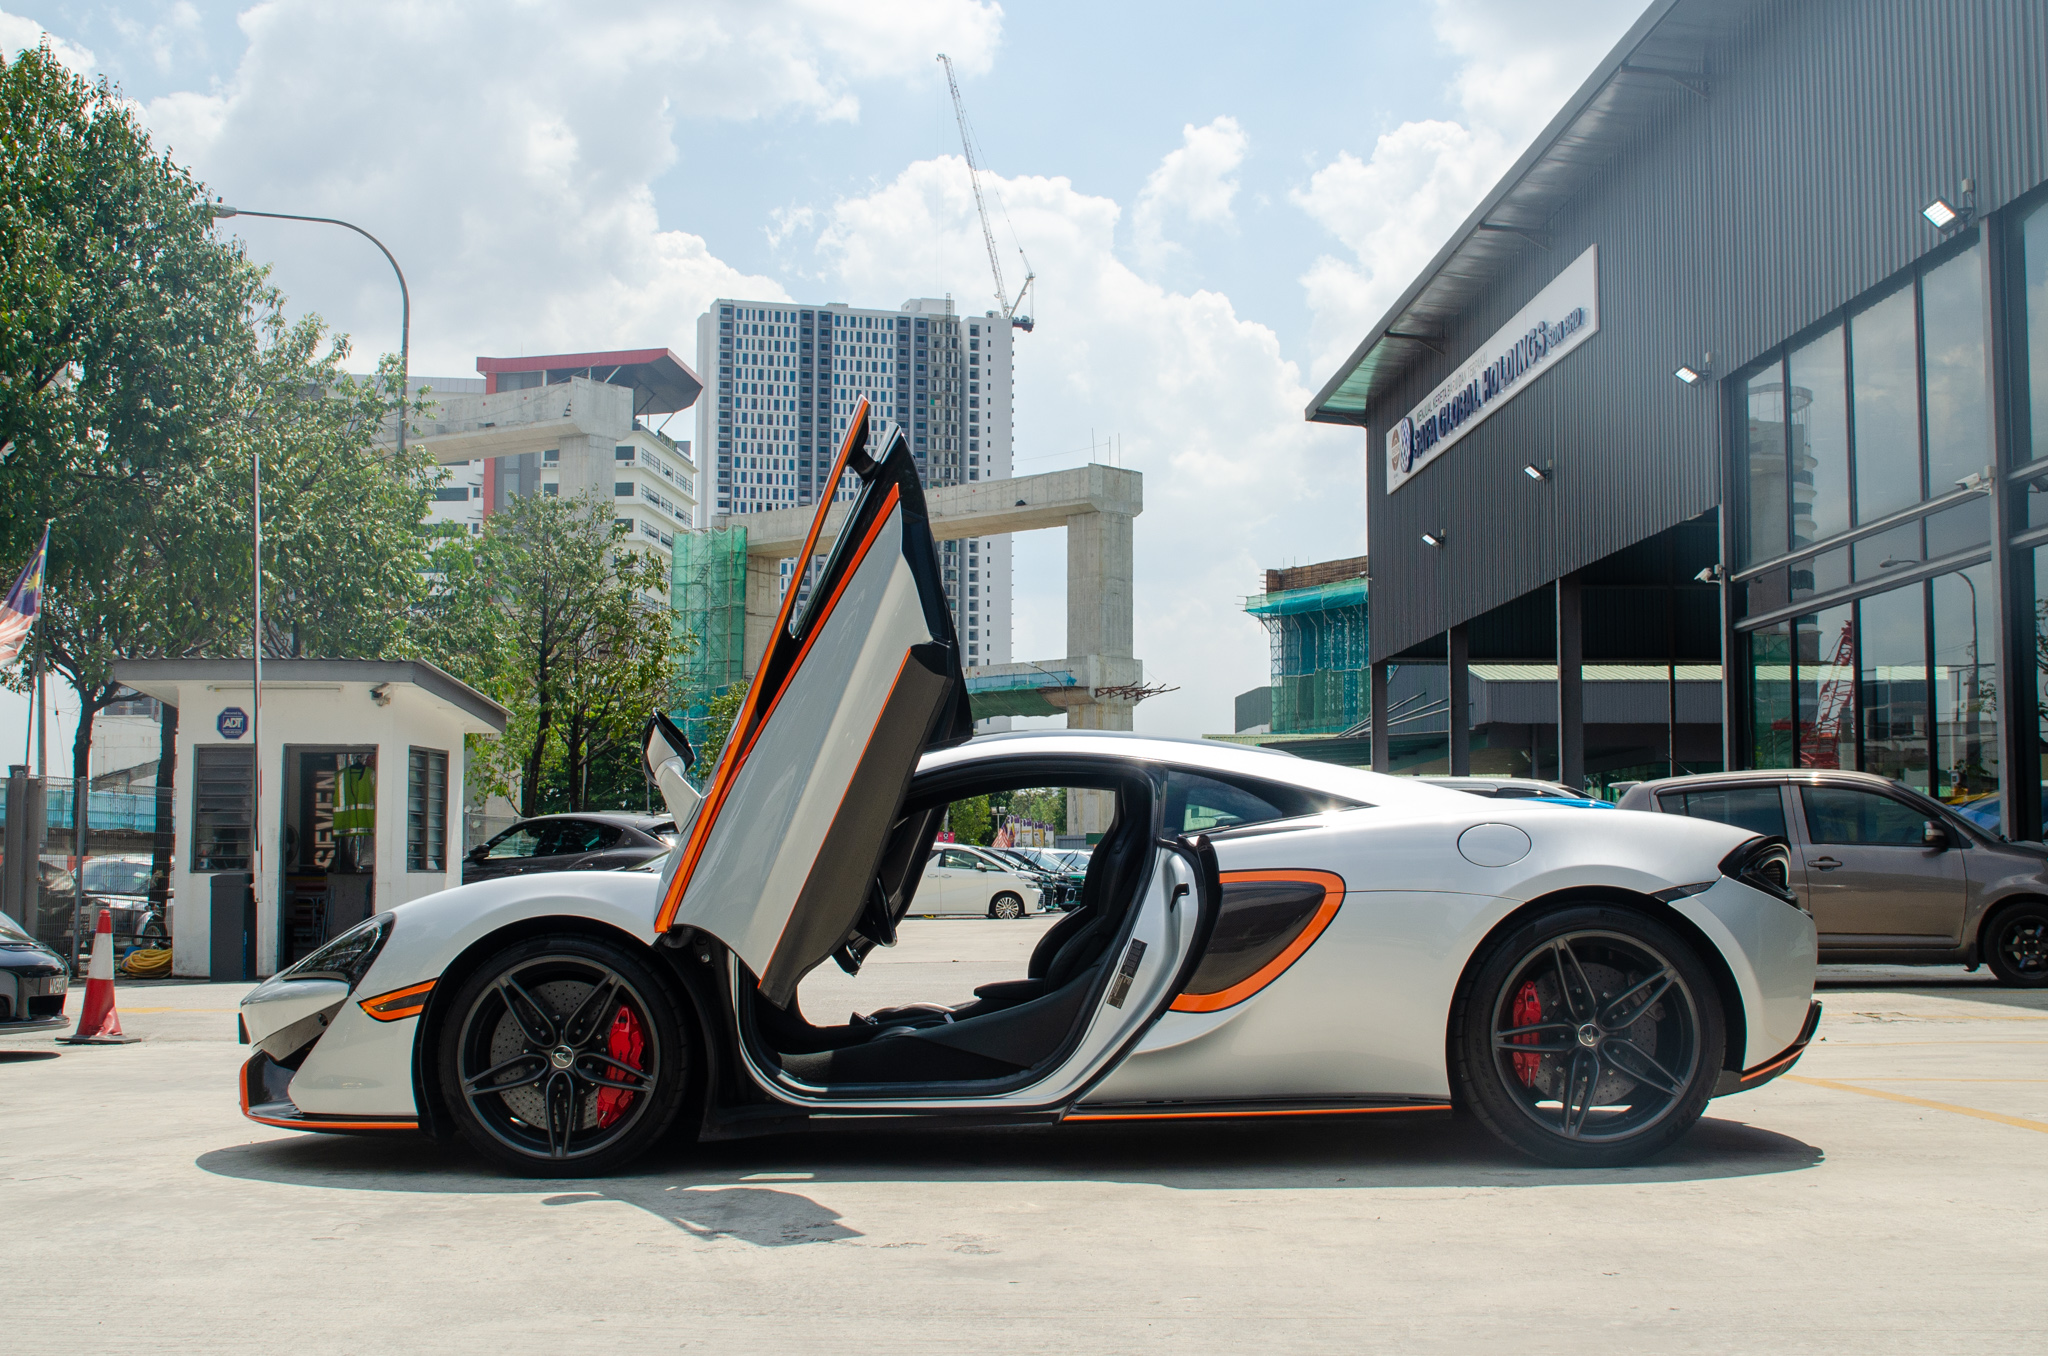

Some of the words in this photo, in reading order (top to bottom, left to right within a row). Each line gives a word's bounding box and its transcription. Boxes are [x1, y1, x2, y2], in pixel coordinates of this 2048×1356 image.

[1414, 415, 1438, 459] SAFA
[1438, 378, 1481, 438] GLOBAL
[1482, 321, 1546, 403] HOLDINGS
[1547, 321, 1565, 348] SDN
[1565, 308, 1582, 335] BHD
[223, 717, 243, 728] ADT
[315, 770, 336, 869] SEVEN
